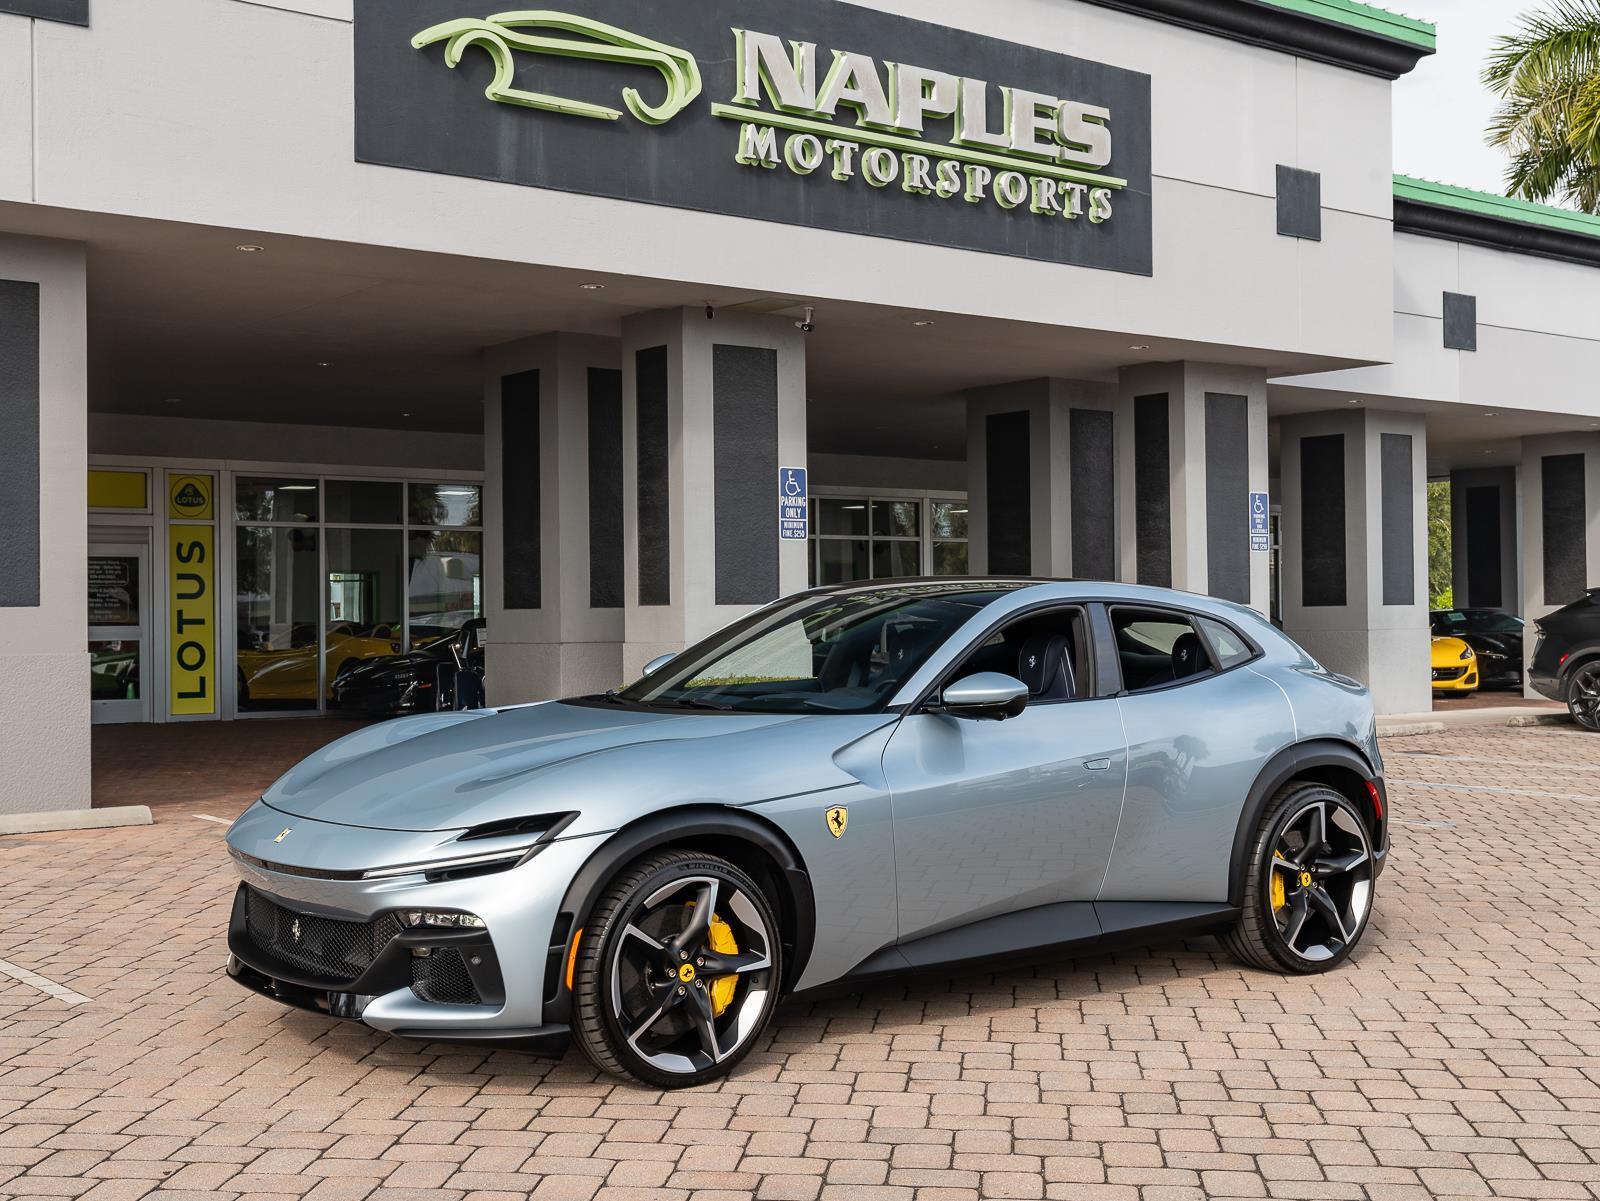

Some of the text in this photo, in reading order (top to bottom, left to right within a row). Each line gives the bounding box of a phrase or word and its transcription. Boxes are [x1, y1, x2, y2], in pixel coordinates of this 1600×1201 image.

[731, 27, 1112, 169] NAPLES
[735, 121, 1114, 225] MOTORSPORTS
[176, 496, 204, 504] LOTUS
[780, 496, 806, 507] PARKING
[785, 508, 802, 518] ONLY
[783, 521, 804, 529] MINIMUM
[794, 530, 805, 538] $250
[176, 540, 206, 700] LOTUS
[688, 863, 729, 874] MICHELIN
